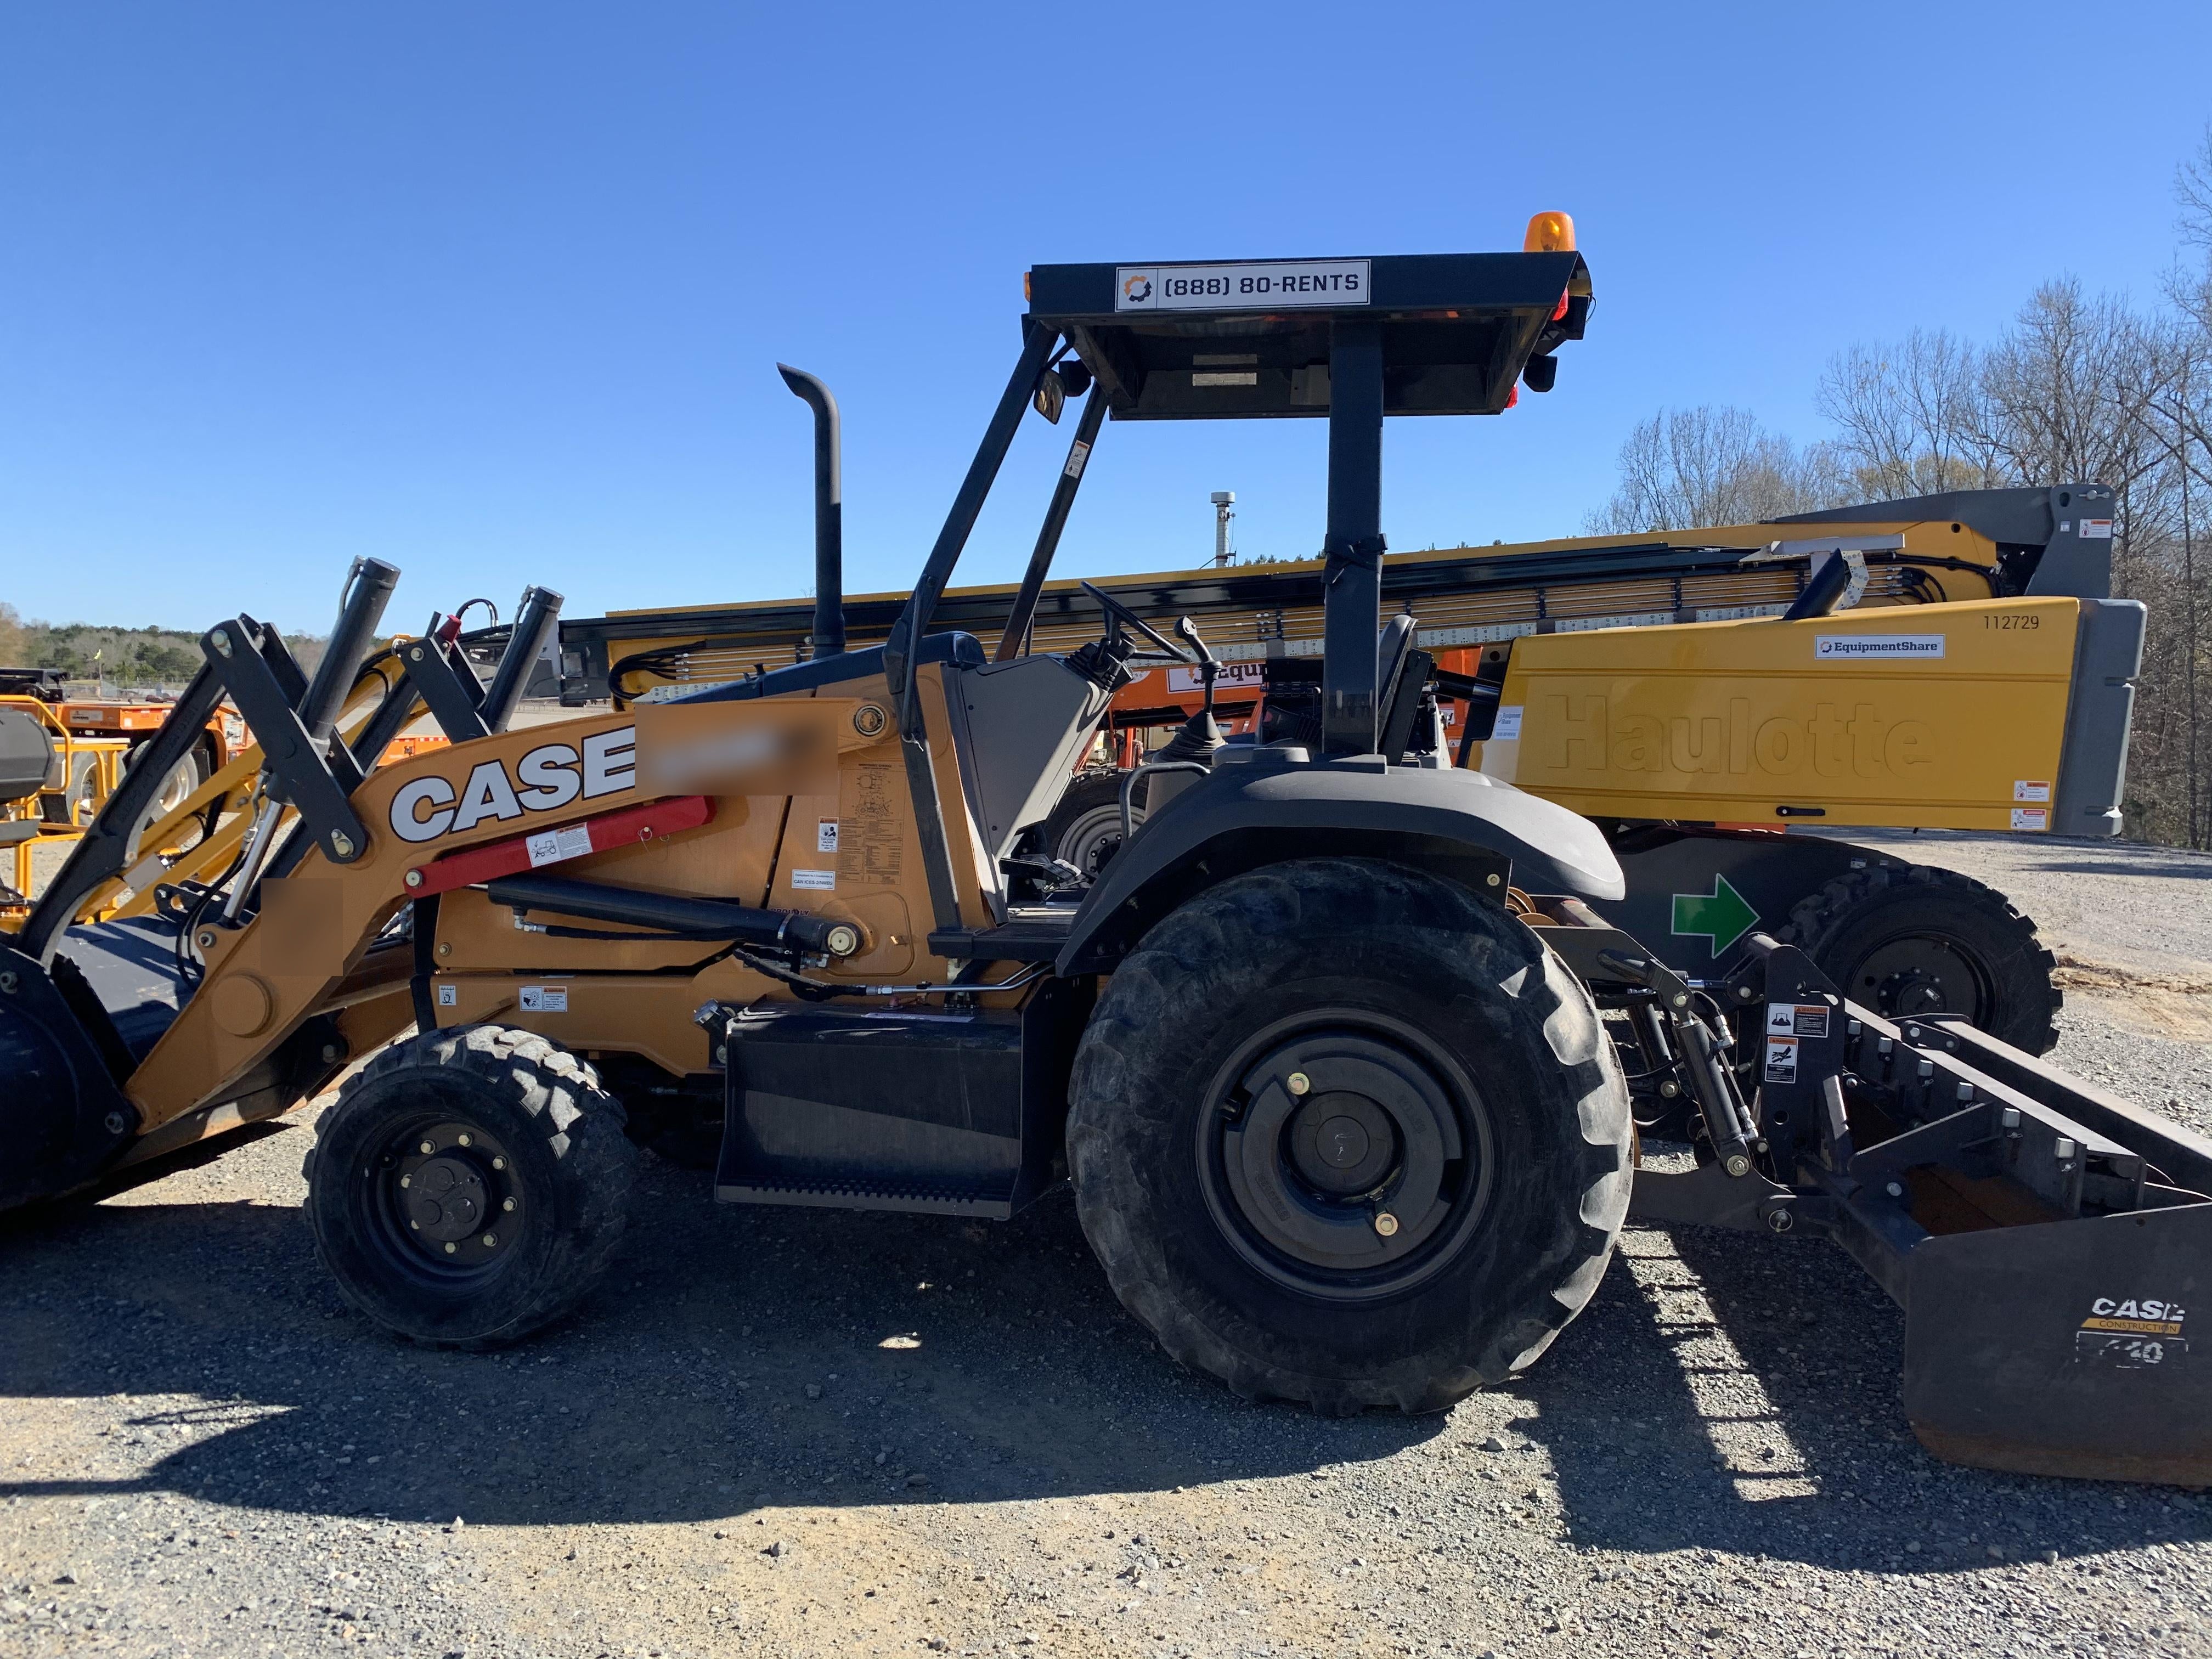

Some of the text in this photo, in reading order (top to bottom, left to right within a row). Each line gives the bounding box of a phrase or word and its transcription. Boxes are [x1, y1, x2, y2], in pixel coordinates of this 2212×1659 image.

[1165, 274, 1359, 297] (888) 80-RENTS
[1984, 616, 2039, 629] 112729
[1834, 641, 1938, 653] EquipmentShare
[1547, 695, 1936, 778] Haulotte
[388, 724, 635, 843] CASE
[2099, 1320, 2177, 1333] CONSTRUCTION
